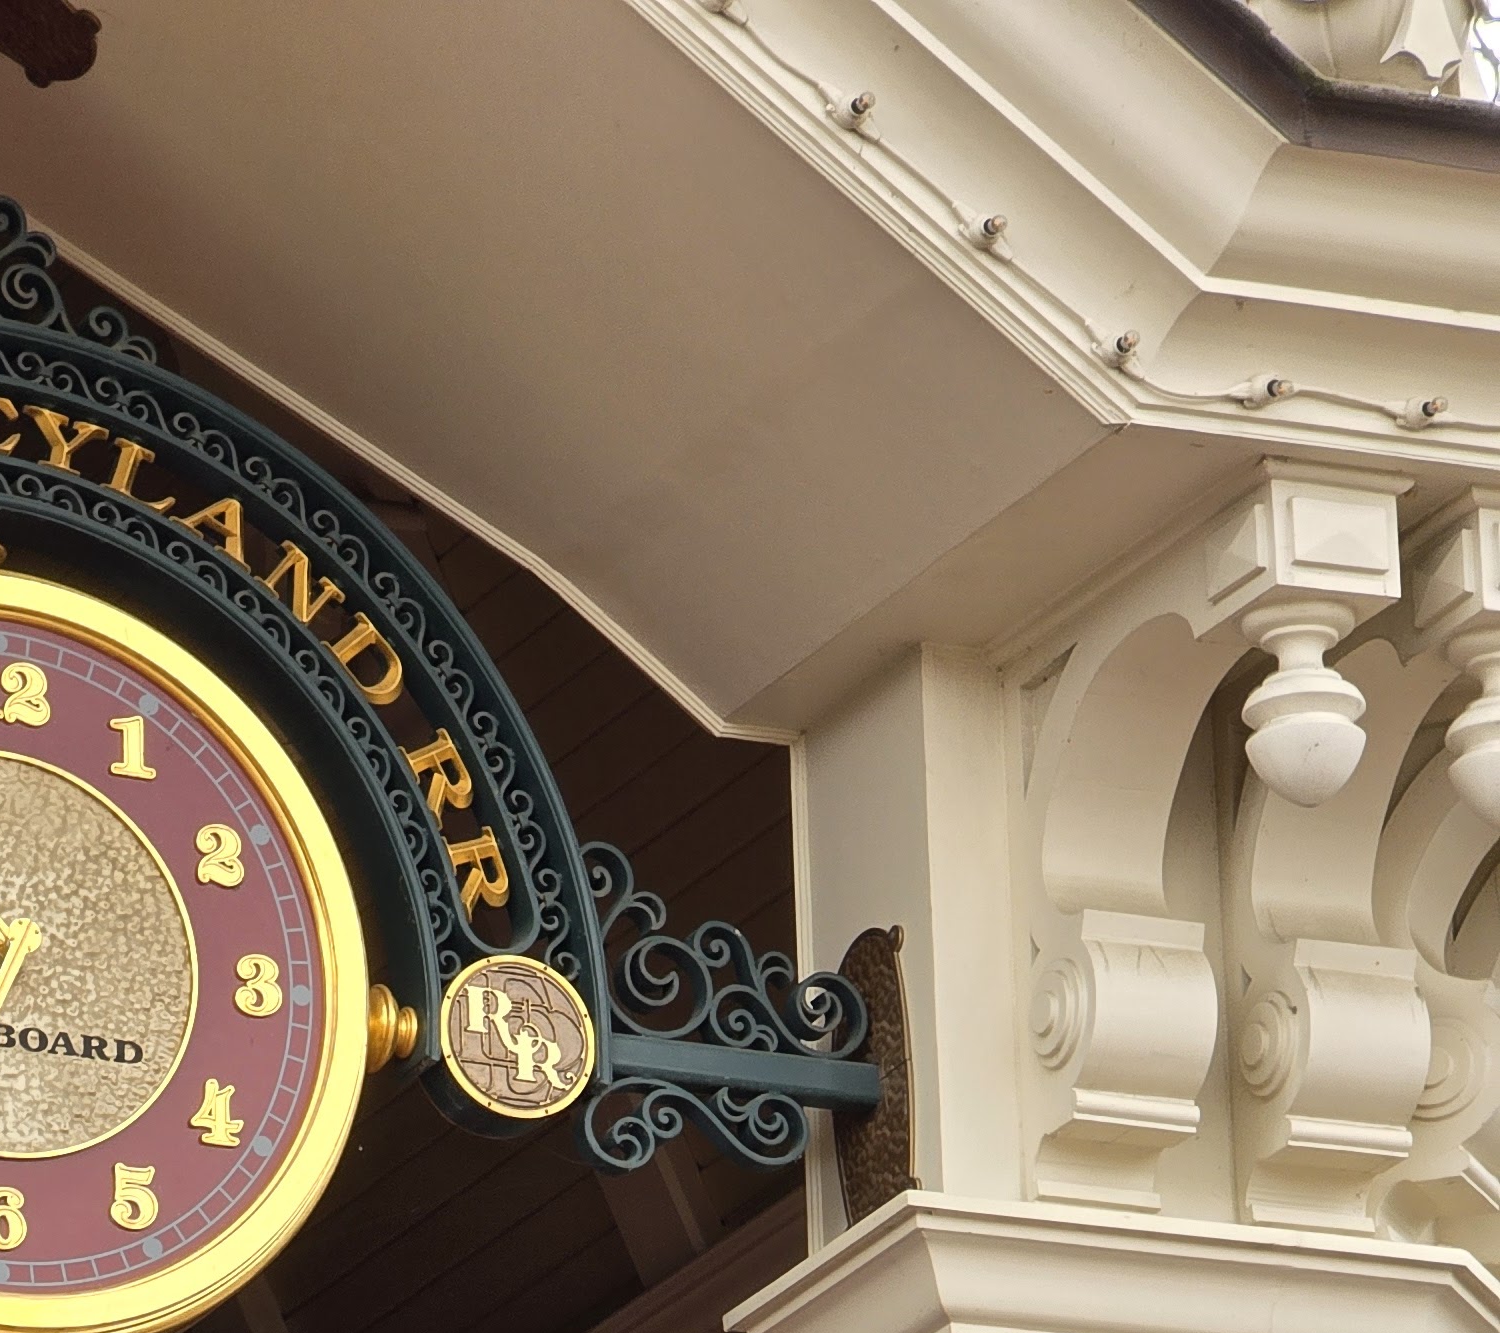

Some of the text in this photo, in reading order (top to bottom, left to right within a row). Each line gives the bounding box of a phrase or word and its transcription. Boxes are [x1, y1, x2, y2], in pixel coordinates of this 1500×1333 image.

[109, 716, 157, 780] 1
[196, 824, 245, 887] 2
[400, 727, 511, 922] RR
[235, 954, 282, 1017] 3
[191, 1080, 244, 1147] 4
[110, 1163, 159, 1229] 5
